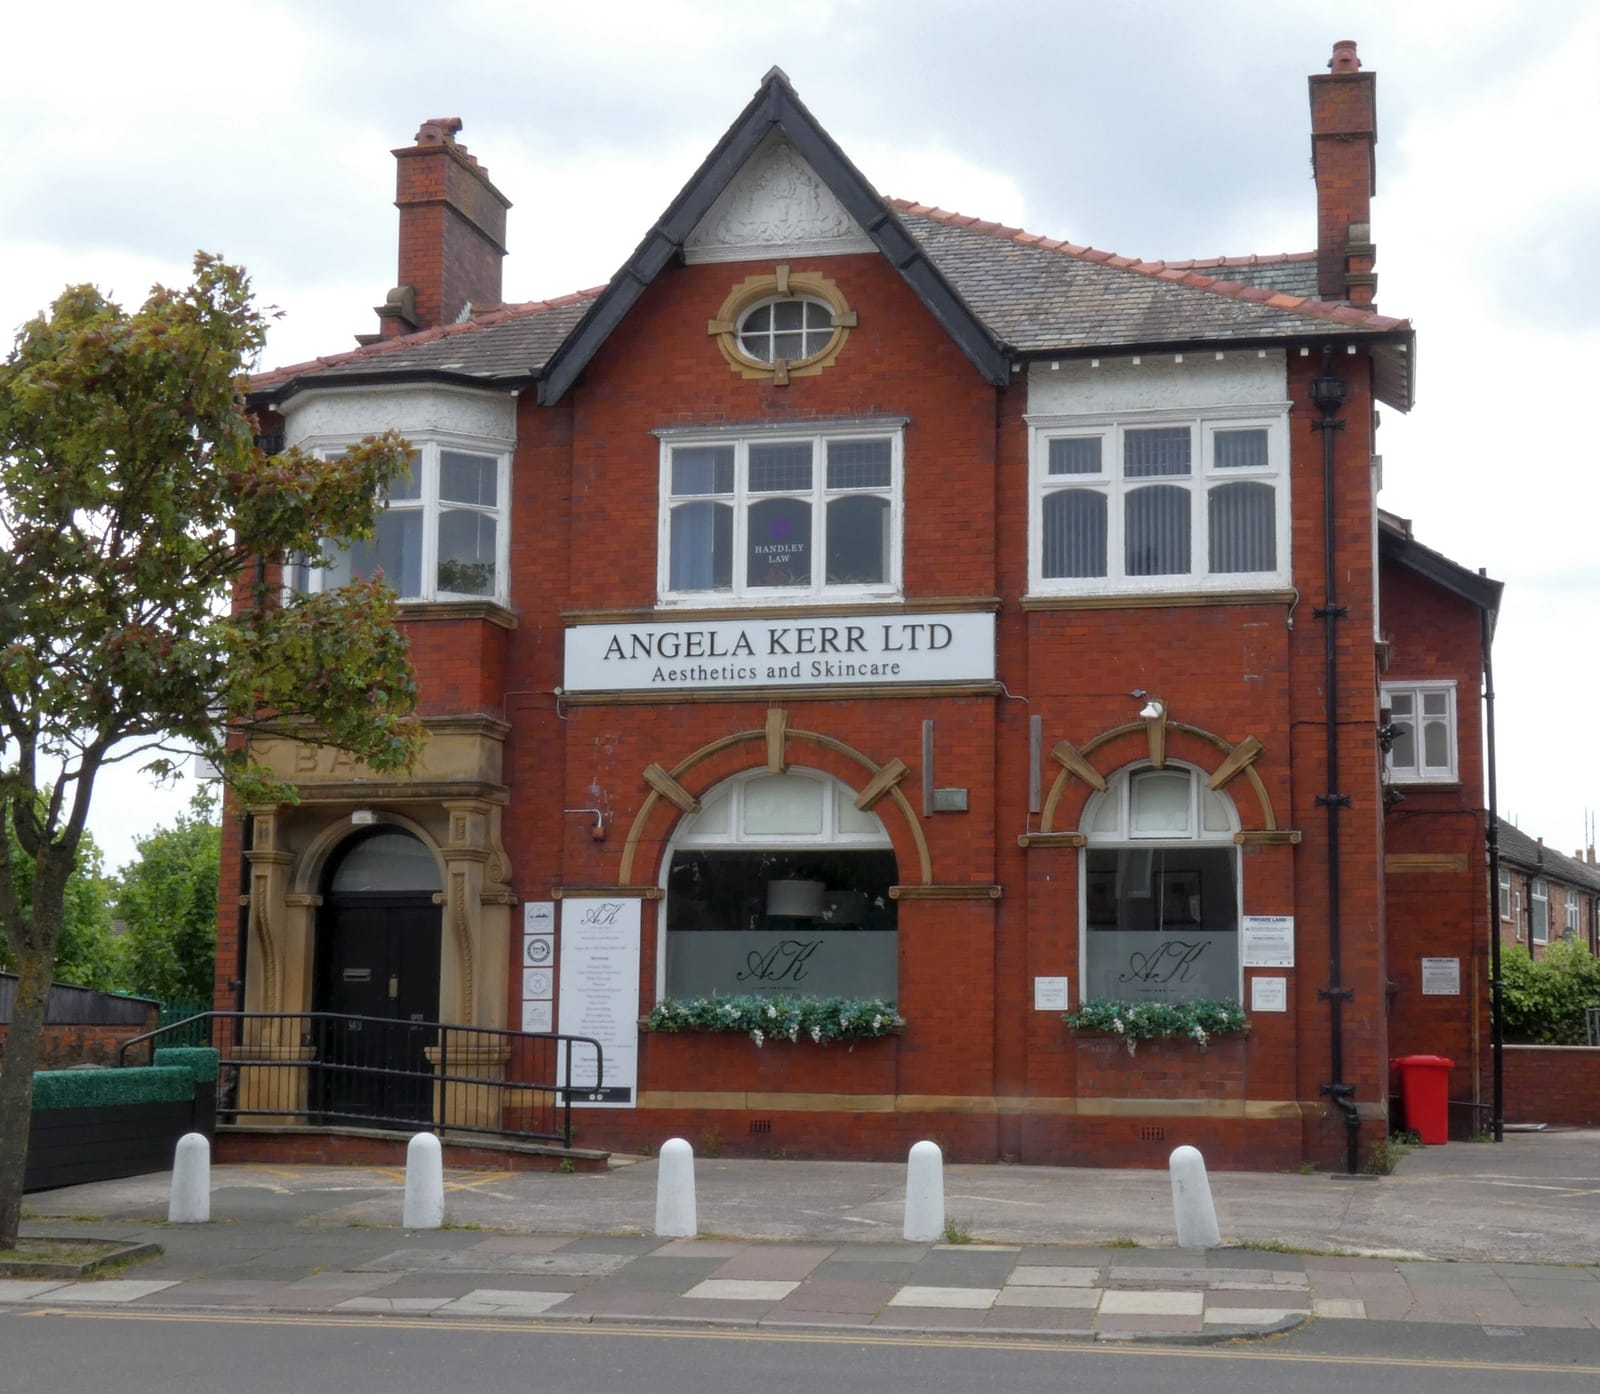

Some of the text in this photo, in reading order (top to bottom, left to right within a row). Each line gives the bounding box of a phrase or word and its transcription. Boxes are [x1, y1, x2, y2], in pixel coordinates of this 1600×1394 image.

[755, 544, 804, 554] HANDLEY
[768, 555, 790, 563] LAW
[603, 623, 953, 660] ANGELA KERR LTD
[651, 659, 902, 682] Aesthetics and Skincare
[736, 940, 824, 982] AK
[1119, 940, 1212, 984] AK
